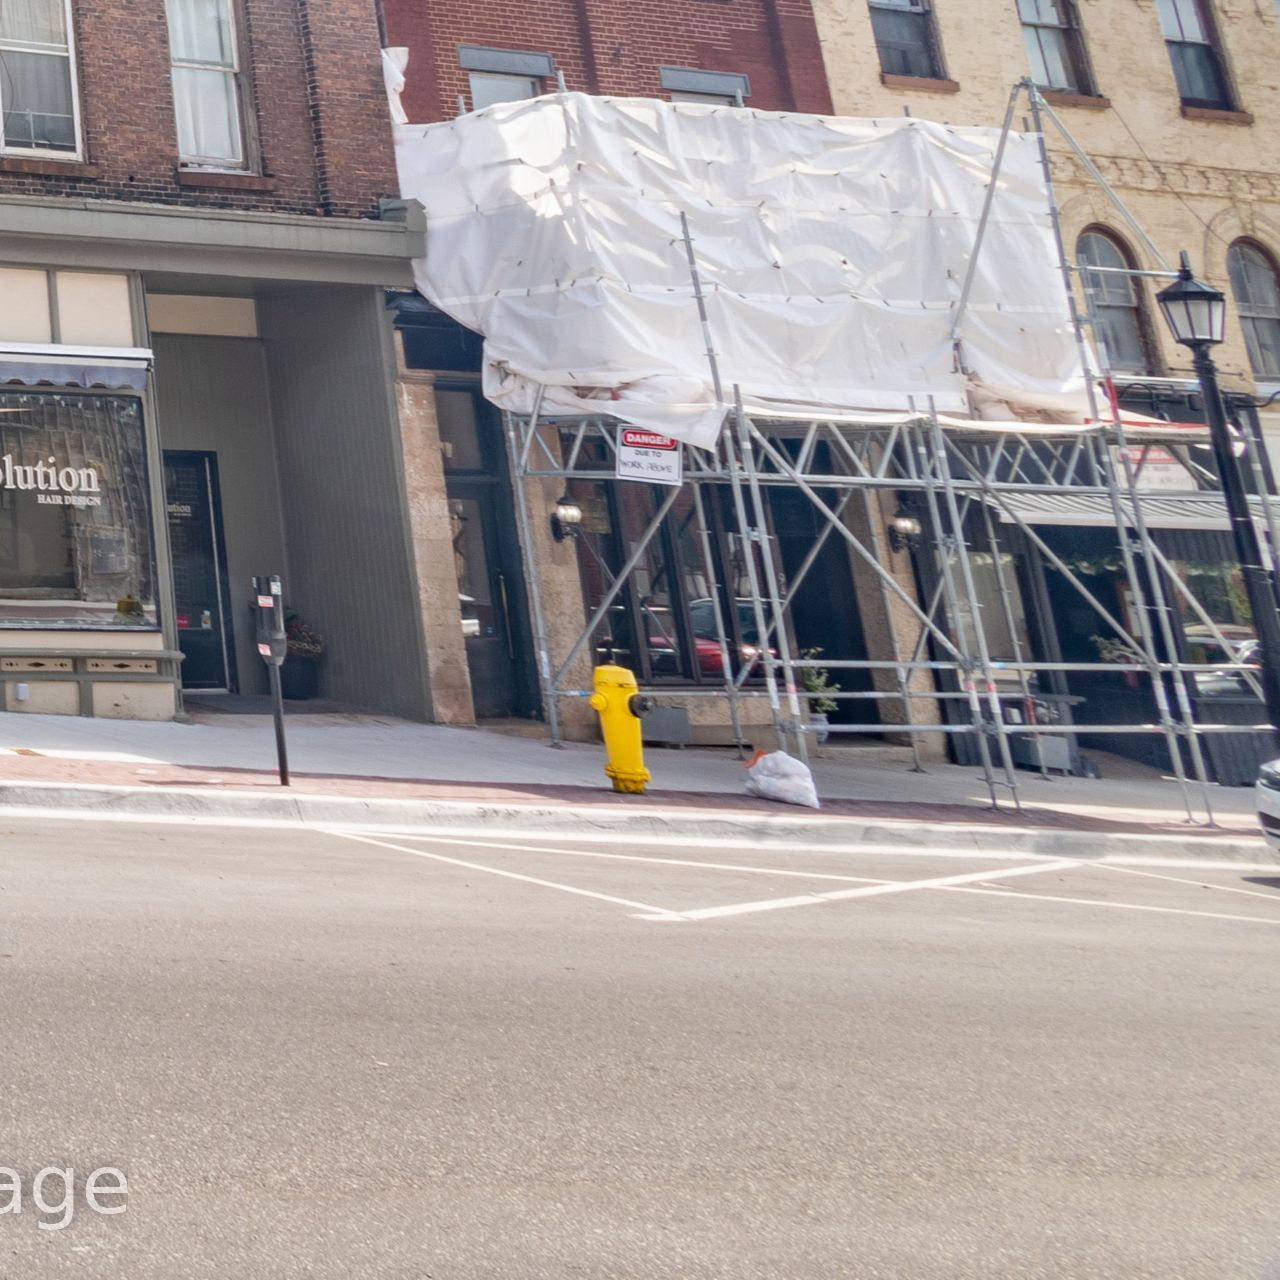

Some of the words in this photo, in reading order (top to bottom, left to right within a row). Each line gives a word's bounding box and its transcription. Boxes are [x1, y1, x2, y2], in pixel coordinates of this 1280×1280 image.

[626, 433, 671, 446] DANGER
[37, 494, 63, 504] HAIR
[64, 494, 101, 506] DESIGN
